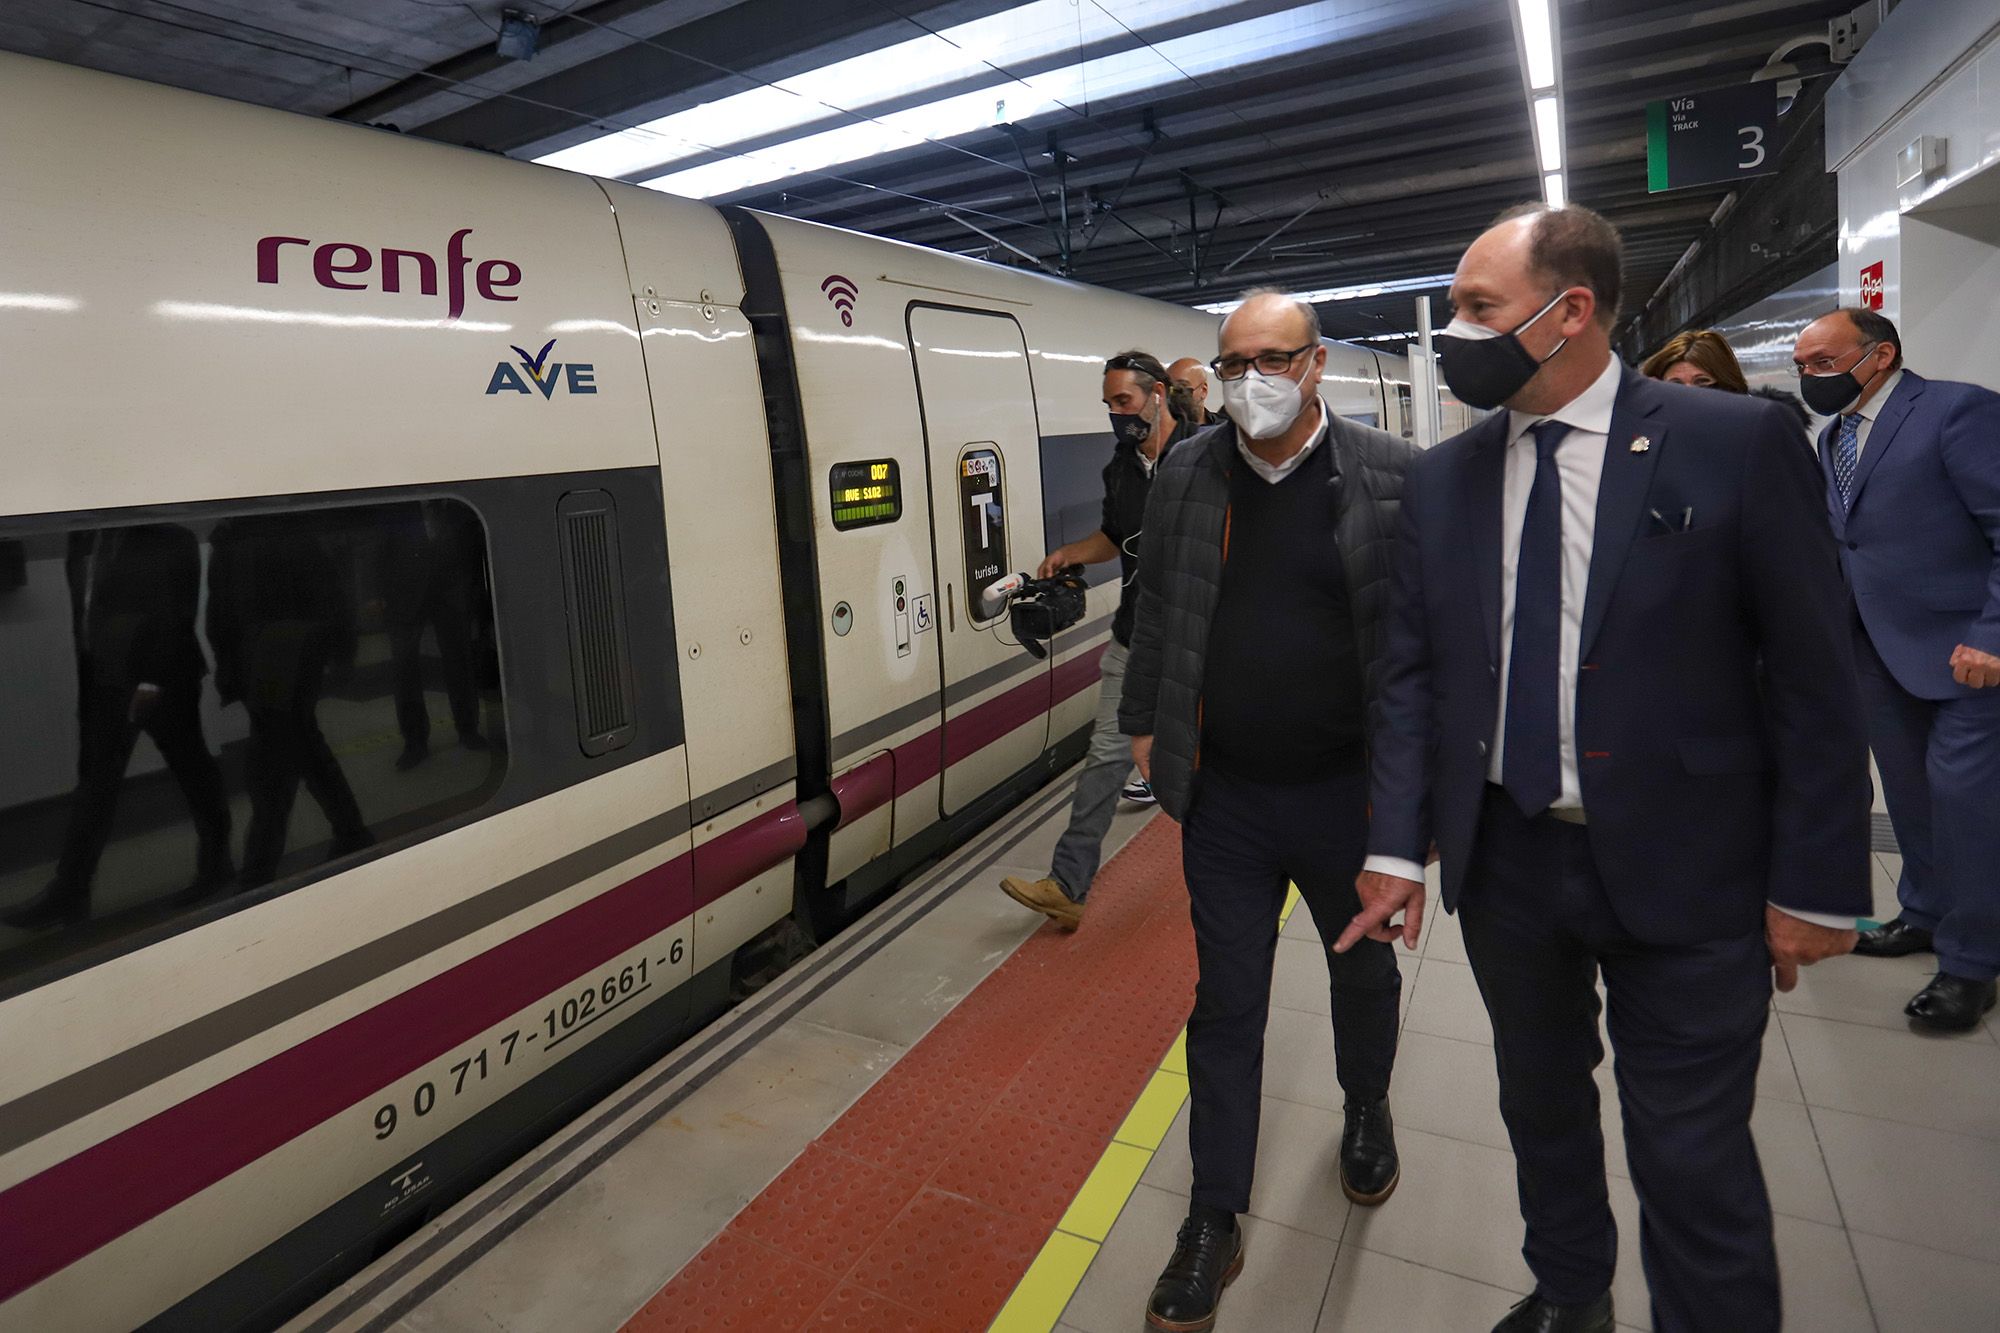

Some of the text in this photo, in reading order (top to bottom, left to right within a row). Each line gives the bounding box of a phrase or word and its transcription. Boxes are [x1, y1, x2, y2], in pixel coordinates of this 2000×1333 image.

[1671, 98, 1695, 112] Vía
[1673, 121, 1699, 132] TRACK
[1737, 126, 1766, 169] 3
[257, 228, 522, 326] renfe
[485, 356, 598, 401] AVE
[870, 464, 888, 480] 007
[845, 486, 882, 502] AVE S102
[971, 492, 993, 549] T
[974, 564, 999, 580] turista
